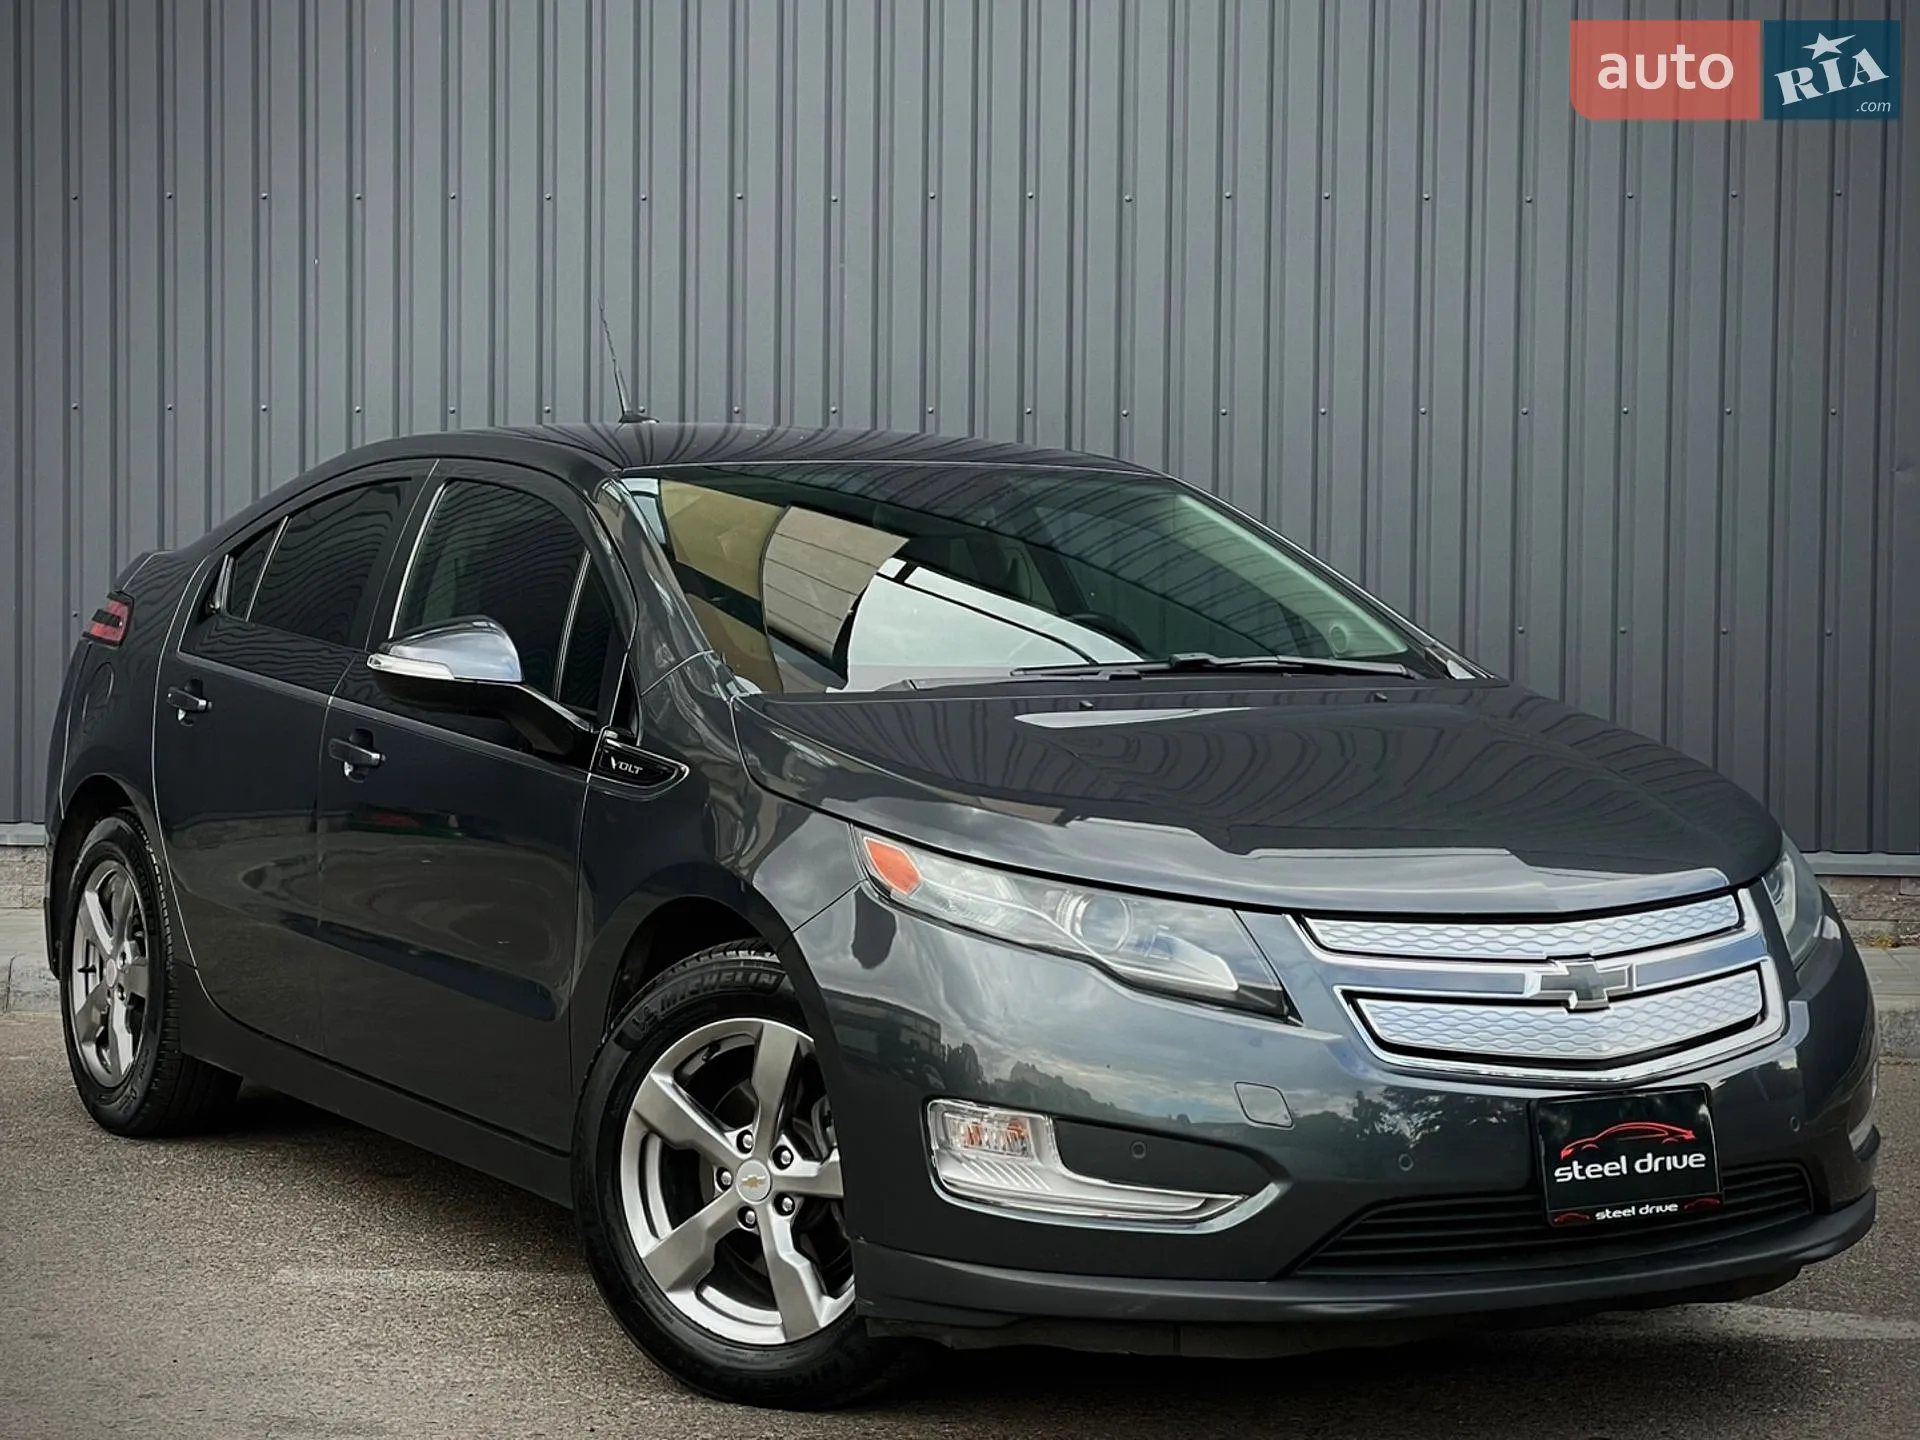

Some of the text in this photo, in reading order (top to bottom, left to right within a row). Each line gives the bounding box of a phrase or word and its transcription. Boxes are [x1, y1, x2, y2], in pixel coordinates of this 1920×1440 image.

[611, 756, 643, 774] VOLT
[1554, 1152, 1706, 1182] steel drive
[1595, 1203, 1678, 1220] steel drive
